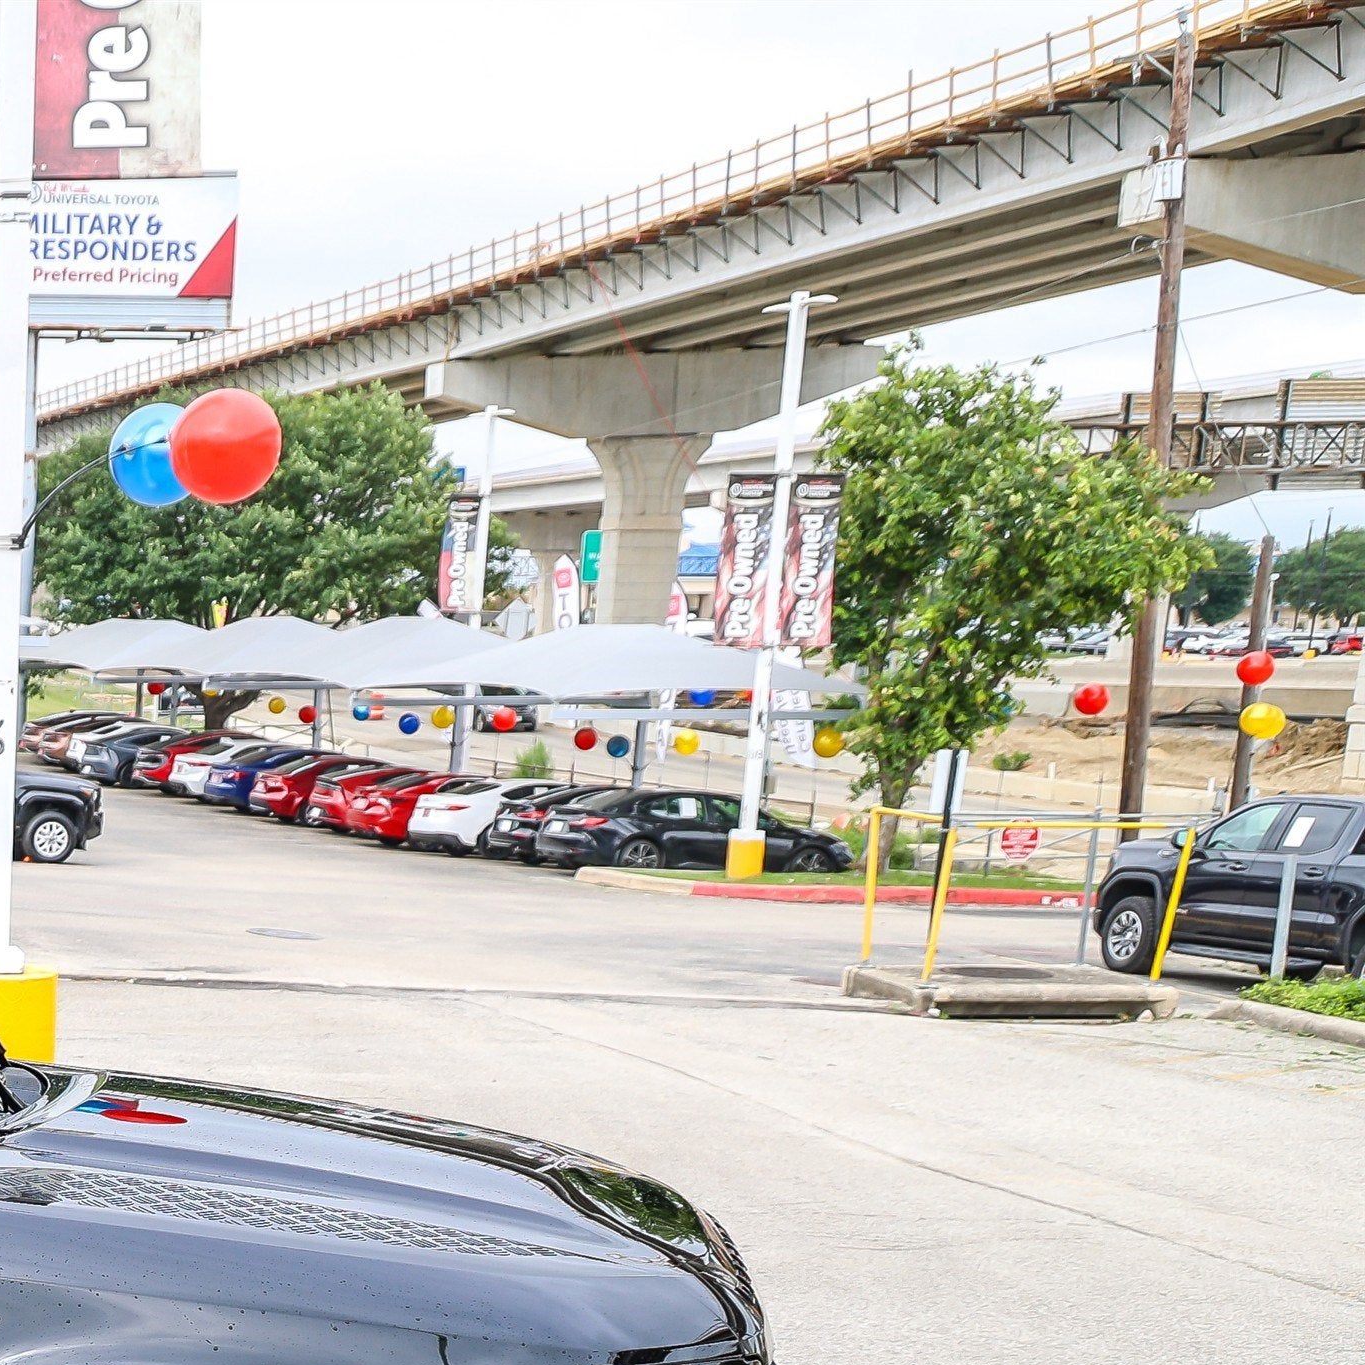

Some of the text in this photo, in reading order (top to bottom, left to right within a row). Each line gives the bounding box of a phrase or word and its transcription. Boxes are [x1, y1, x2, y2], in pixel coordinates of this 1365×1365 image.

[72, 25, 150, 149] Pre
[43, 193, 160, 206] UNIVERSAL TOYOTA
[146, 213, 163, 236] &
[33, 266, 180, 288] Preferred Pricing
[447, 521, 469, 579] Owned
[728, 513, 759, 596] Owned
[793, 514, 825, 596] Owned
[447, 578, 466, 608] Pre
[724, 598, 751, 638] Pre
[790, 598, 817, 638] Pre
